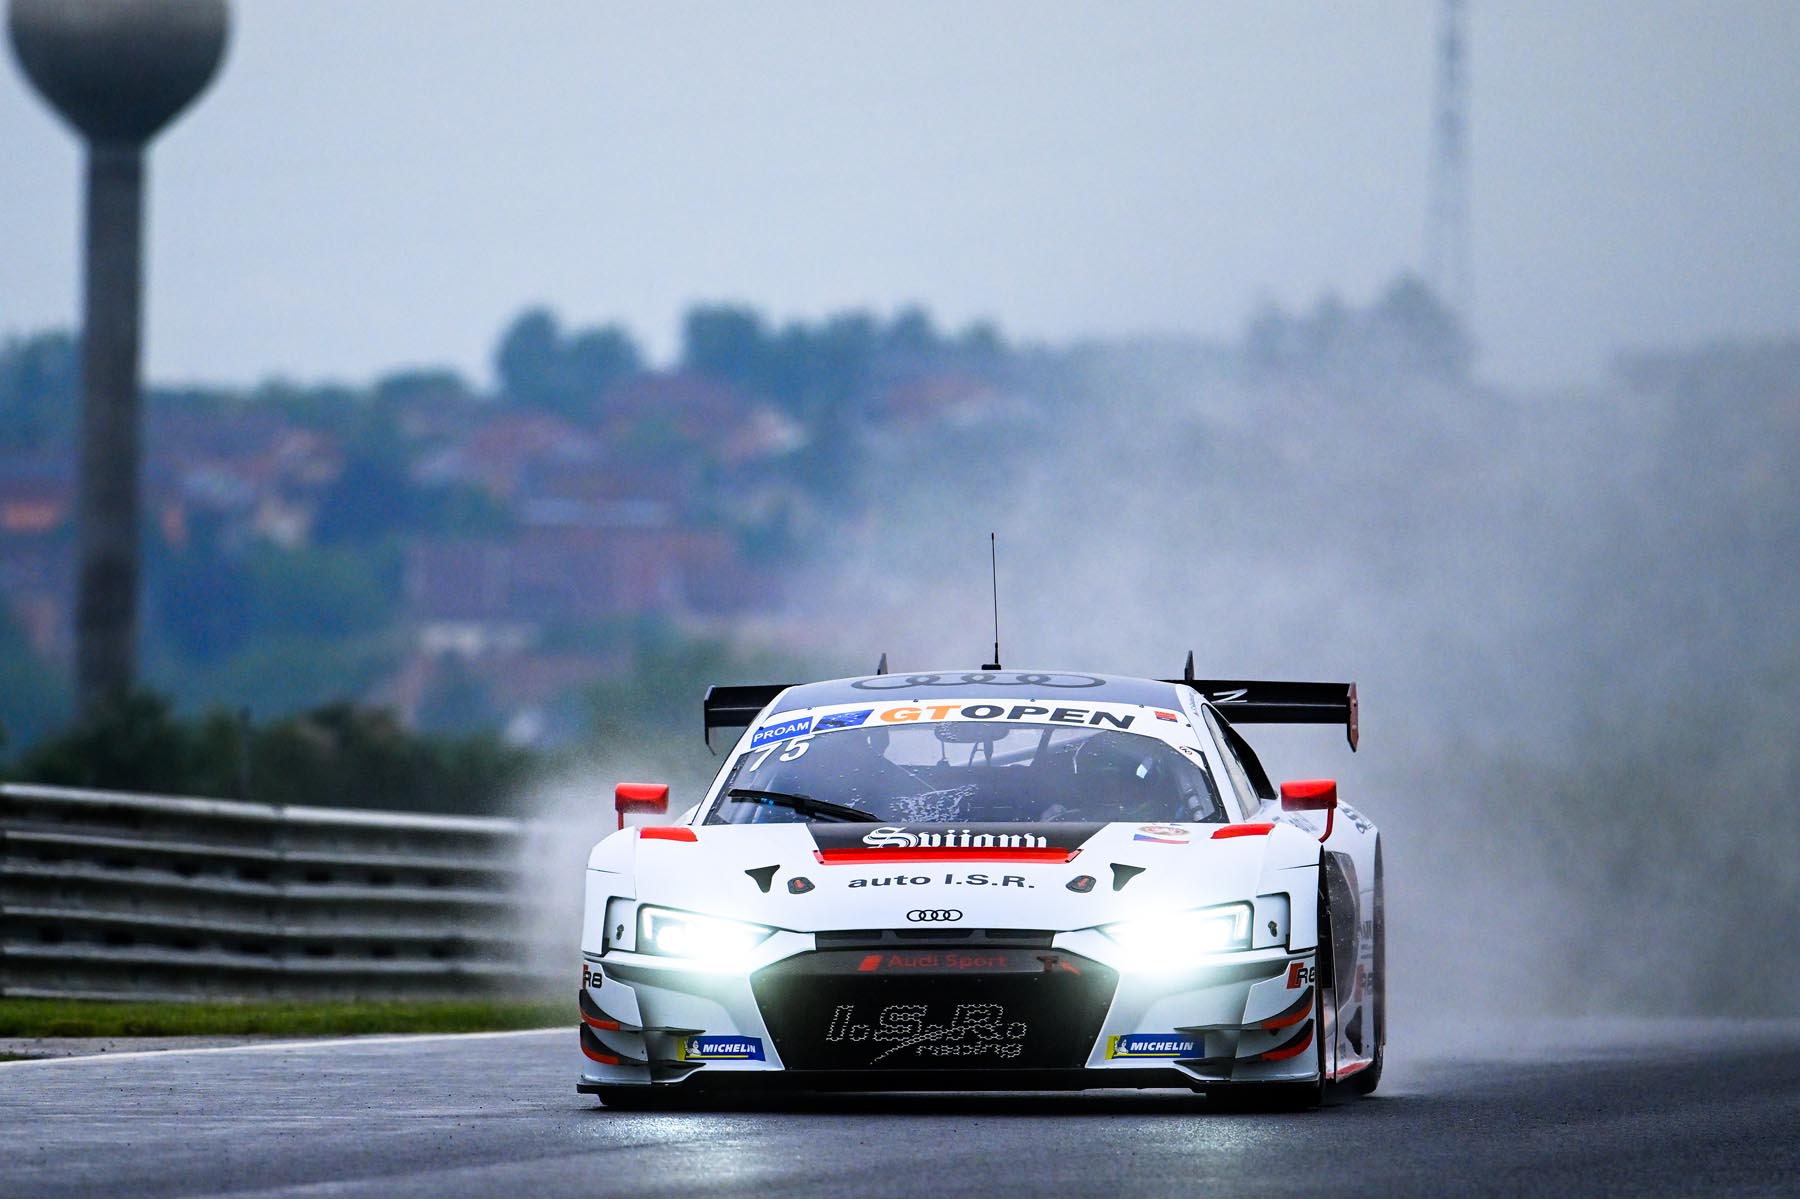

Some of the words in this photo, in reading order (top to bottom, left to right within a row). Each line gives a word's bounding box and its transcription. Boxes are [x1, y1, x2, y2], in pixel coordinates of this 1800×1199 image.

[753, 721, 810, 743] PROAM
[748, 733, 816, 773] 75
[848, 874, 931, 889] auto
[944, 873, 1036, 889] I.S.R.
[887, 954, 938, 968] Audi
[945, 954, 1008, 969] Sport
[702, 1043, 757, 1054] MICHELIN
[1130, 1041, 1194, 1051] MICHELIN
